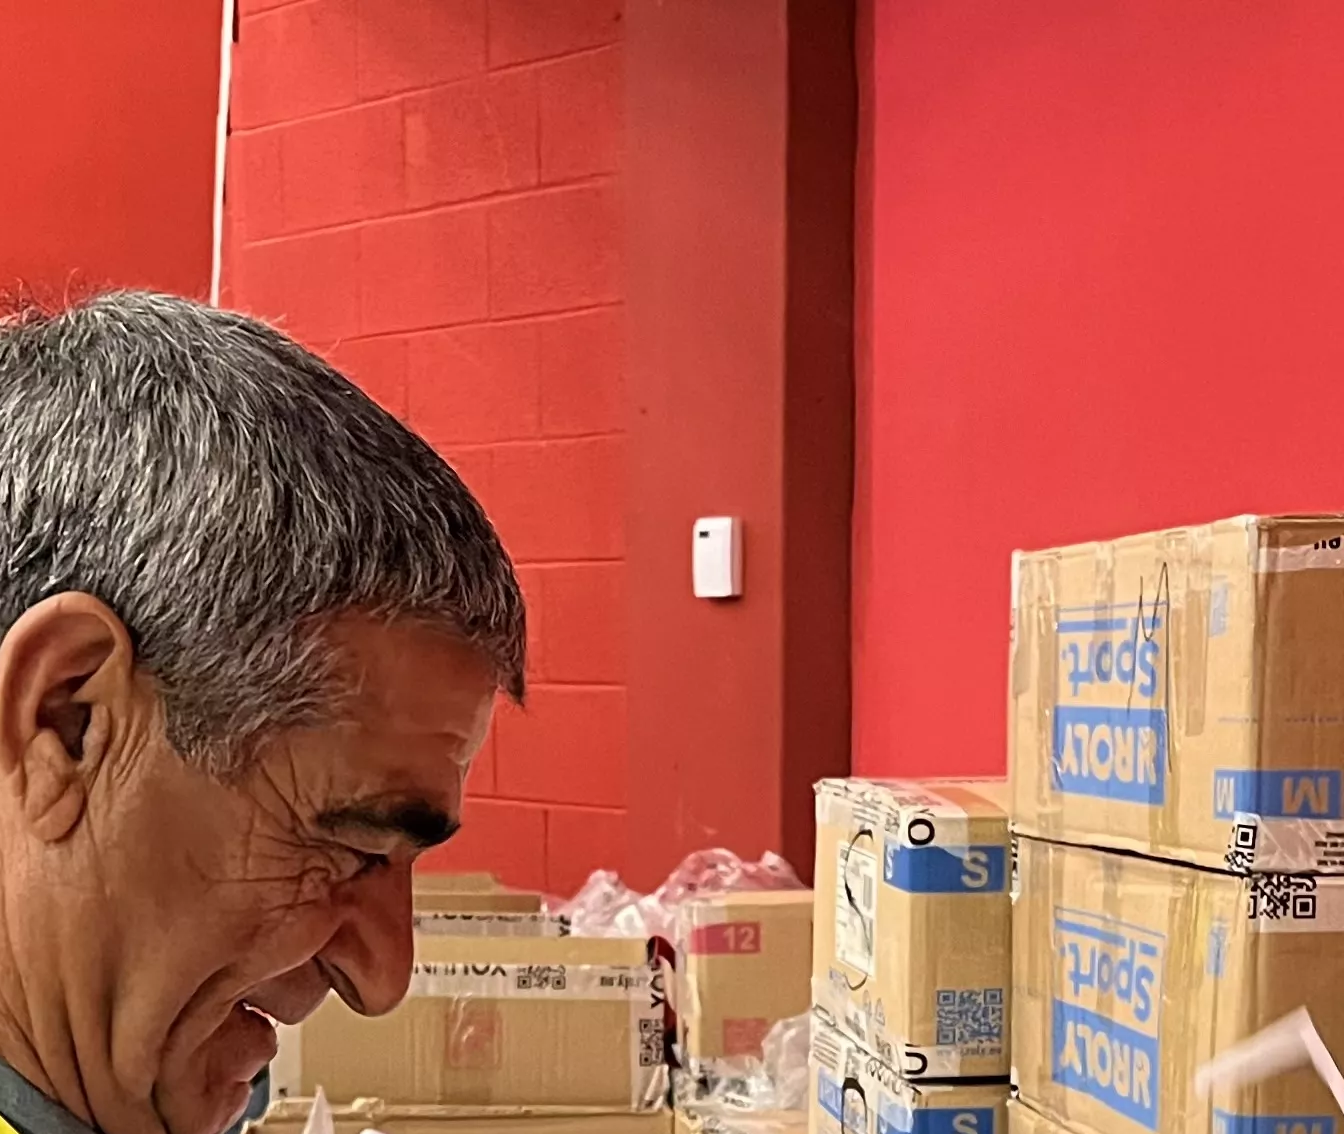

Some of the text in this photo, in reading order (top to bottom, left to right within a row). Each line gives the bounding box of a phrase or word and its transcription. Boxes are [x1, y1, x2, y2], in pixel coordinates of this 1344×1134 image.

[1282, 777, 1330, 814] M
[961, 850, 990, 889] S
[723, 929, 755, 950] 12
